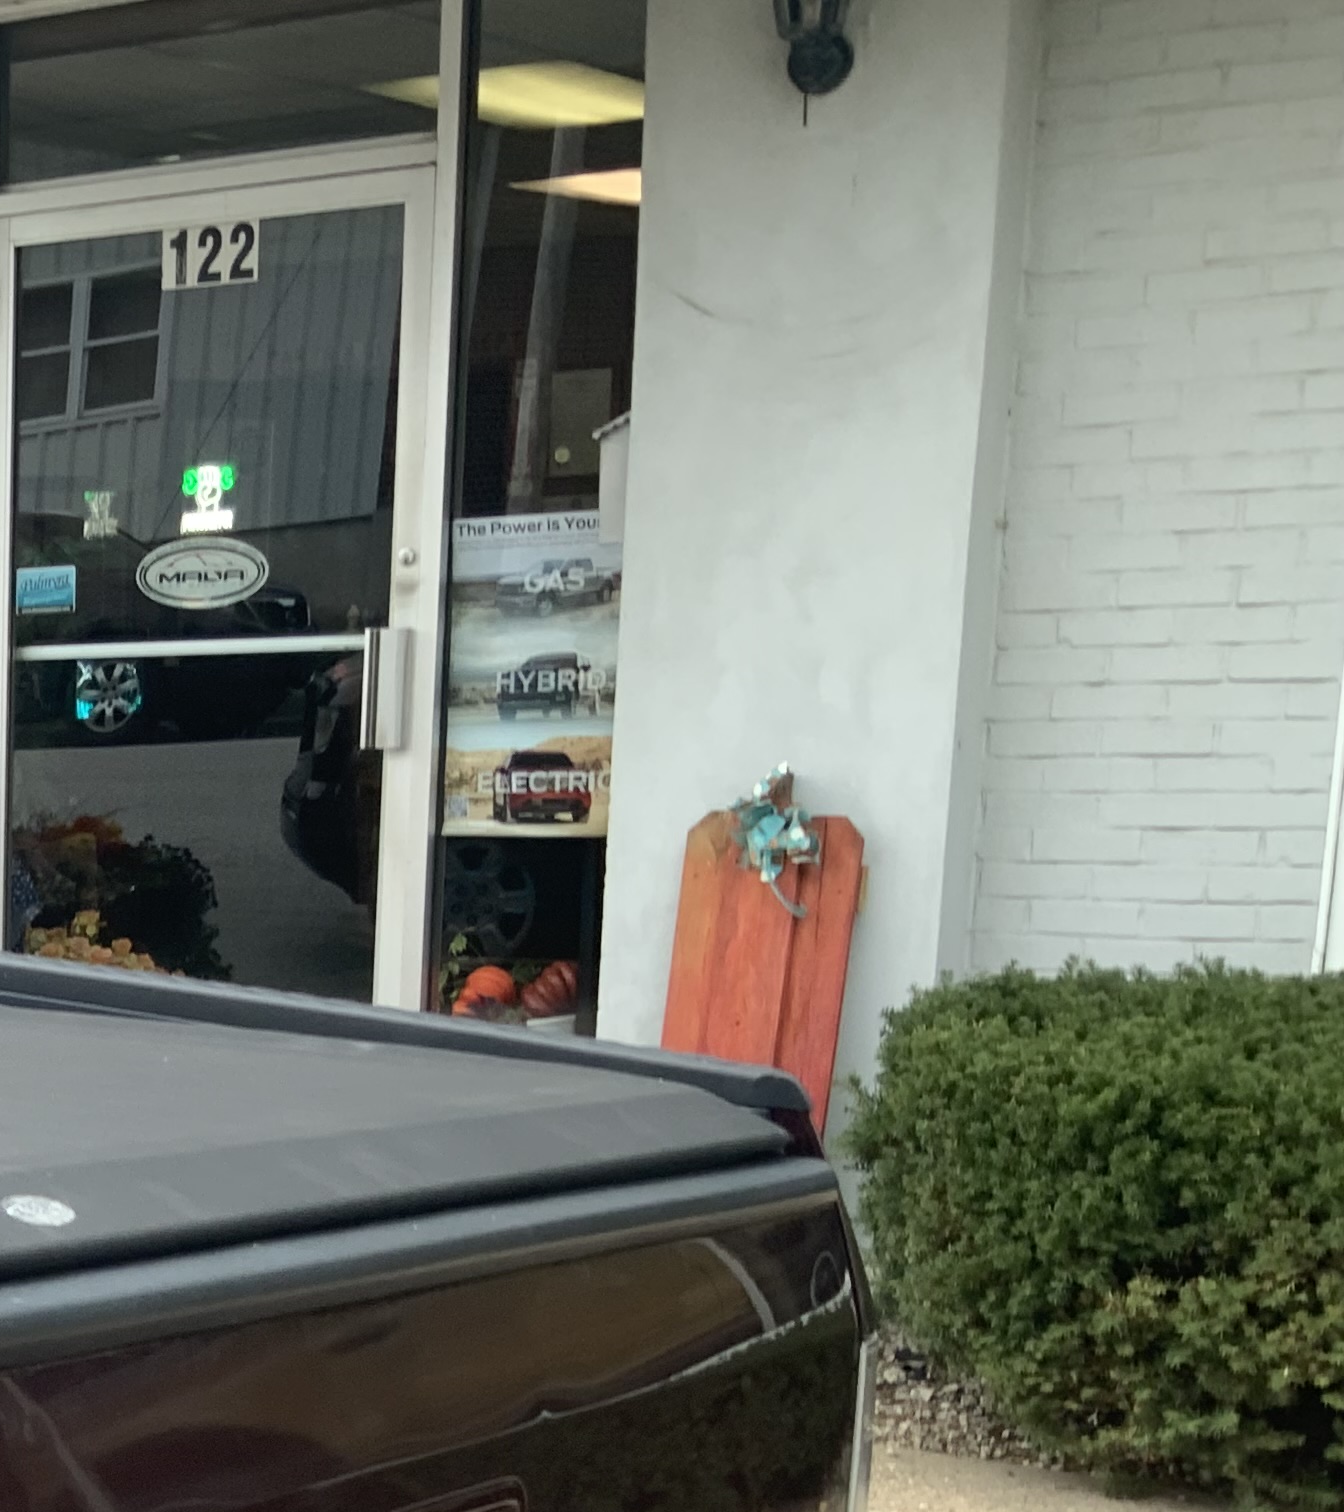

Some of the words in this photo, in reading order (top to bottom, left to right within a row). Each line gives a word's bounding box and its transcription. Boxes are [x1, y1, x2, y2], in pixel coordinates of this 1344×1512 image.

[170, 224, 255, 285] 122
[456, 522, 486, 537] The
[490, 520, 543, 535] Power
[523, 567, 585, 593] GAS
[496, 668, 606, 694] HYBRID
[476, 769, 611, 794] ELECTRIC
